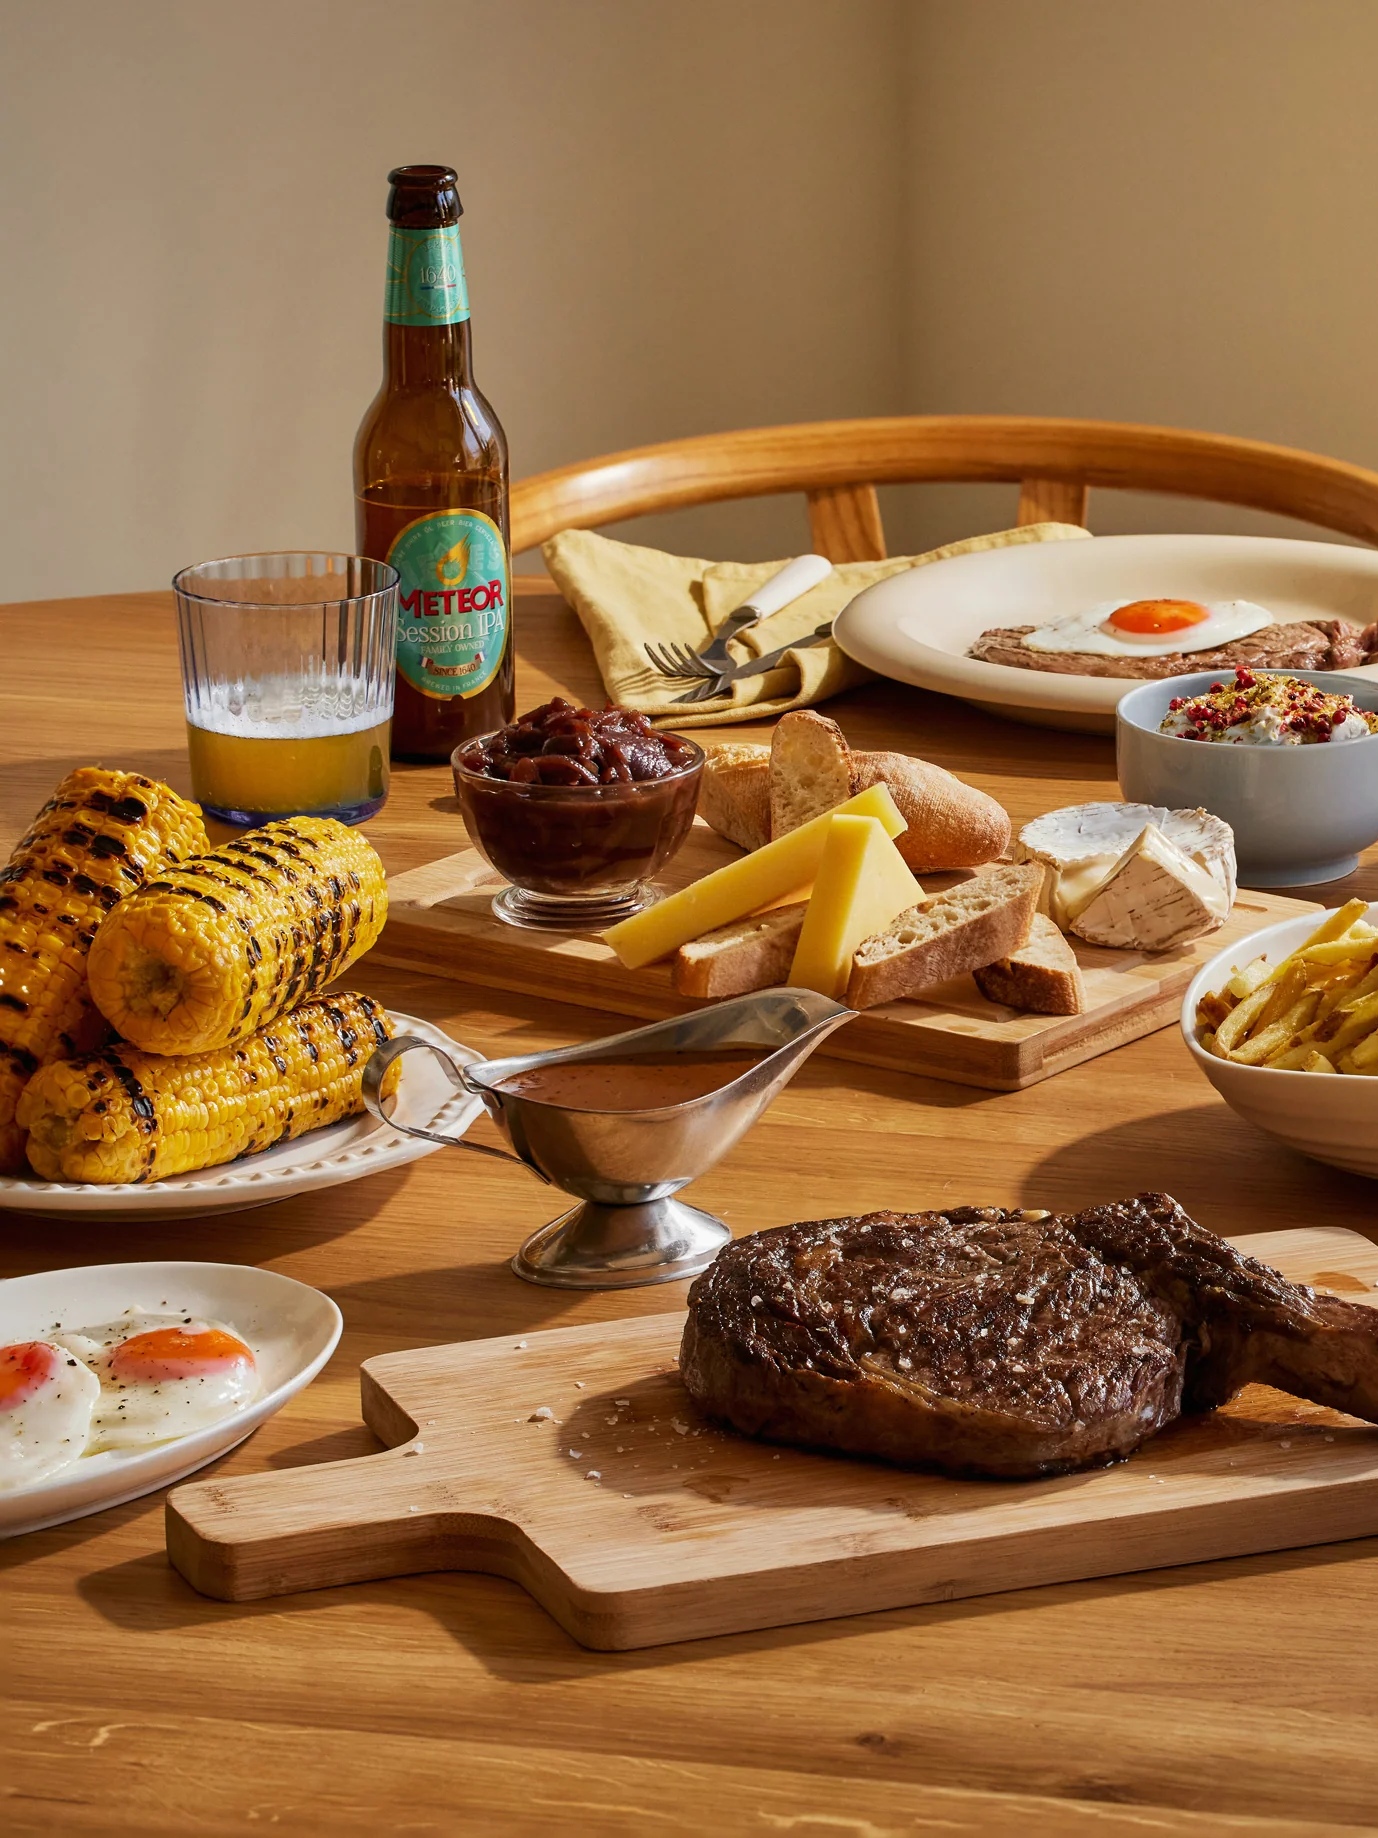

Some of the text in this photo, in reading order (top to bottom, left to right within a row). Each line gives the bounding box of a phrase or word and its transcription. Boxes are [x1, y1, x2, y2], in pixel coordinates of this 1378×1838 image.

[420, 264, 456, 283] 1640
[437, 519, 455, 528] BEER
[458, 519, 473, 528] BIER
[399, 579, 504, 618] METEOR
[396, 607, 505, 643] Session IPA
[421, 640, 485, 655] FAMILY OWNED
[433, 663, 476, 676] SINCE 1640
[462, 671, 487, 689] FRANCE
